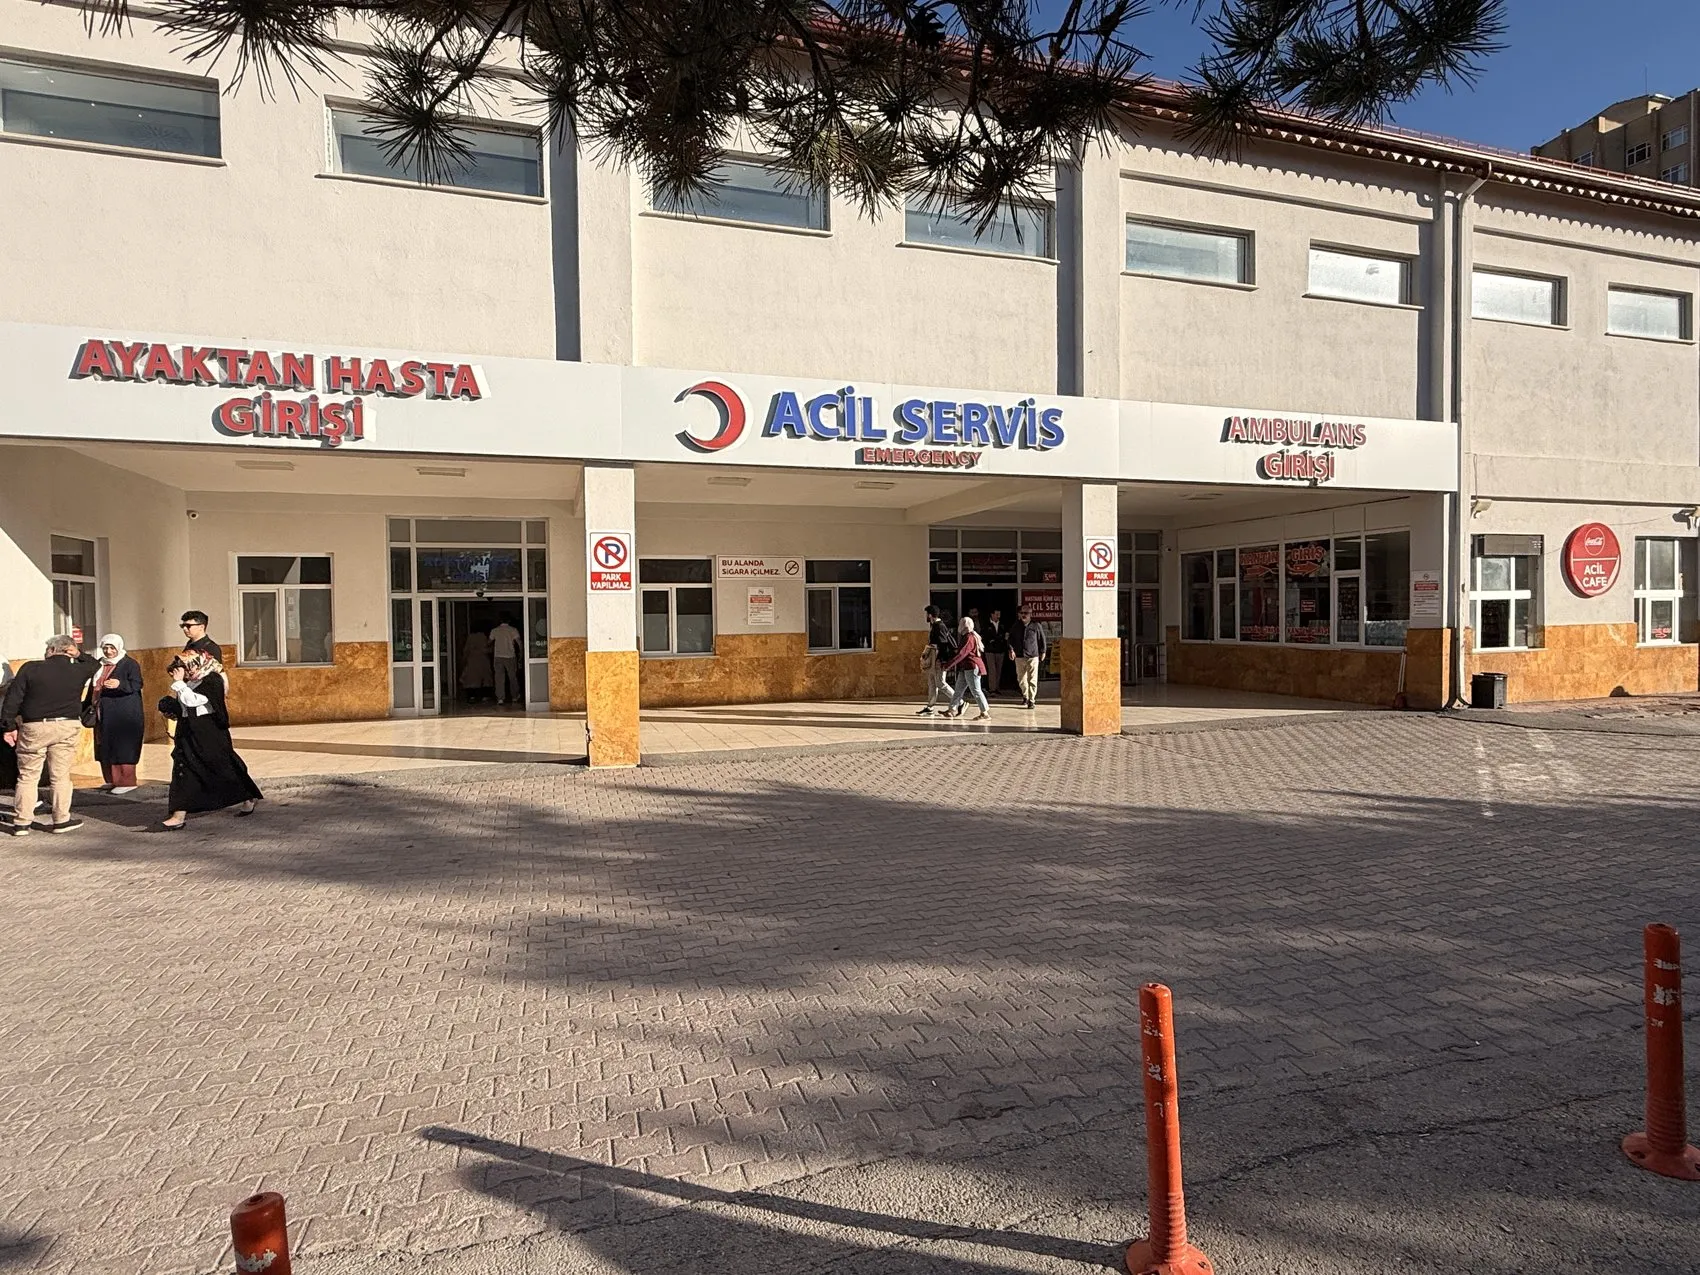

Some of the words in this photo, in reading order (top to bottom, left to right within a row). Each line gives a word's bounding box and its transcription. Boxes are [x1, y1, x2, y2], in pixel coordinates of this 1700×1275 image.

[75, 338, 316, 391] AYAKTAN
[329, 355, 482, 399] HASTA
[219, 391, 365, 447] GİRİŞİ
[768, 385, 888, 440] ACİL
[899, 397, 1065, 448] SERVİS
[1228, 415, 1367, 447] AMBULANS
[862, 446, 982, 467] EMERGENCY
[1263, 448, 1336, 484] GİRİŞİ
[721, 559, 733, 567] BU
[734, 559, 765, 567] ALANDA
[1583, 562, 1606, 576] ACİL
[601, 573, 622, 581] PARK
[1582, 576, 1609, 588] CAFE
[1045, 602, 1063, 611] SERV
